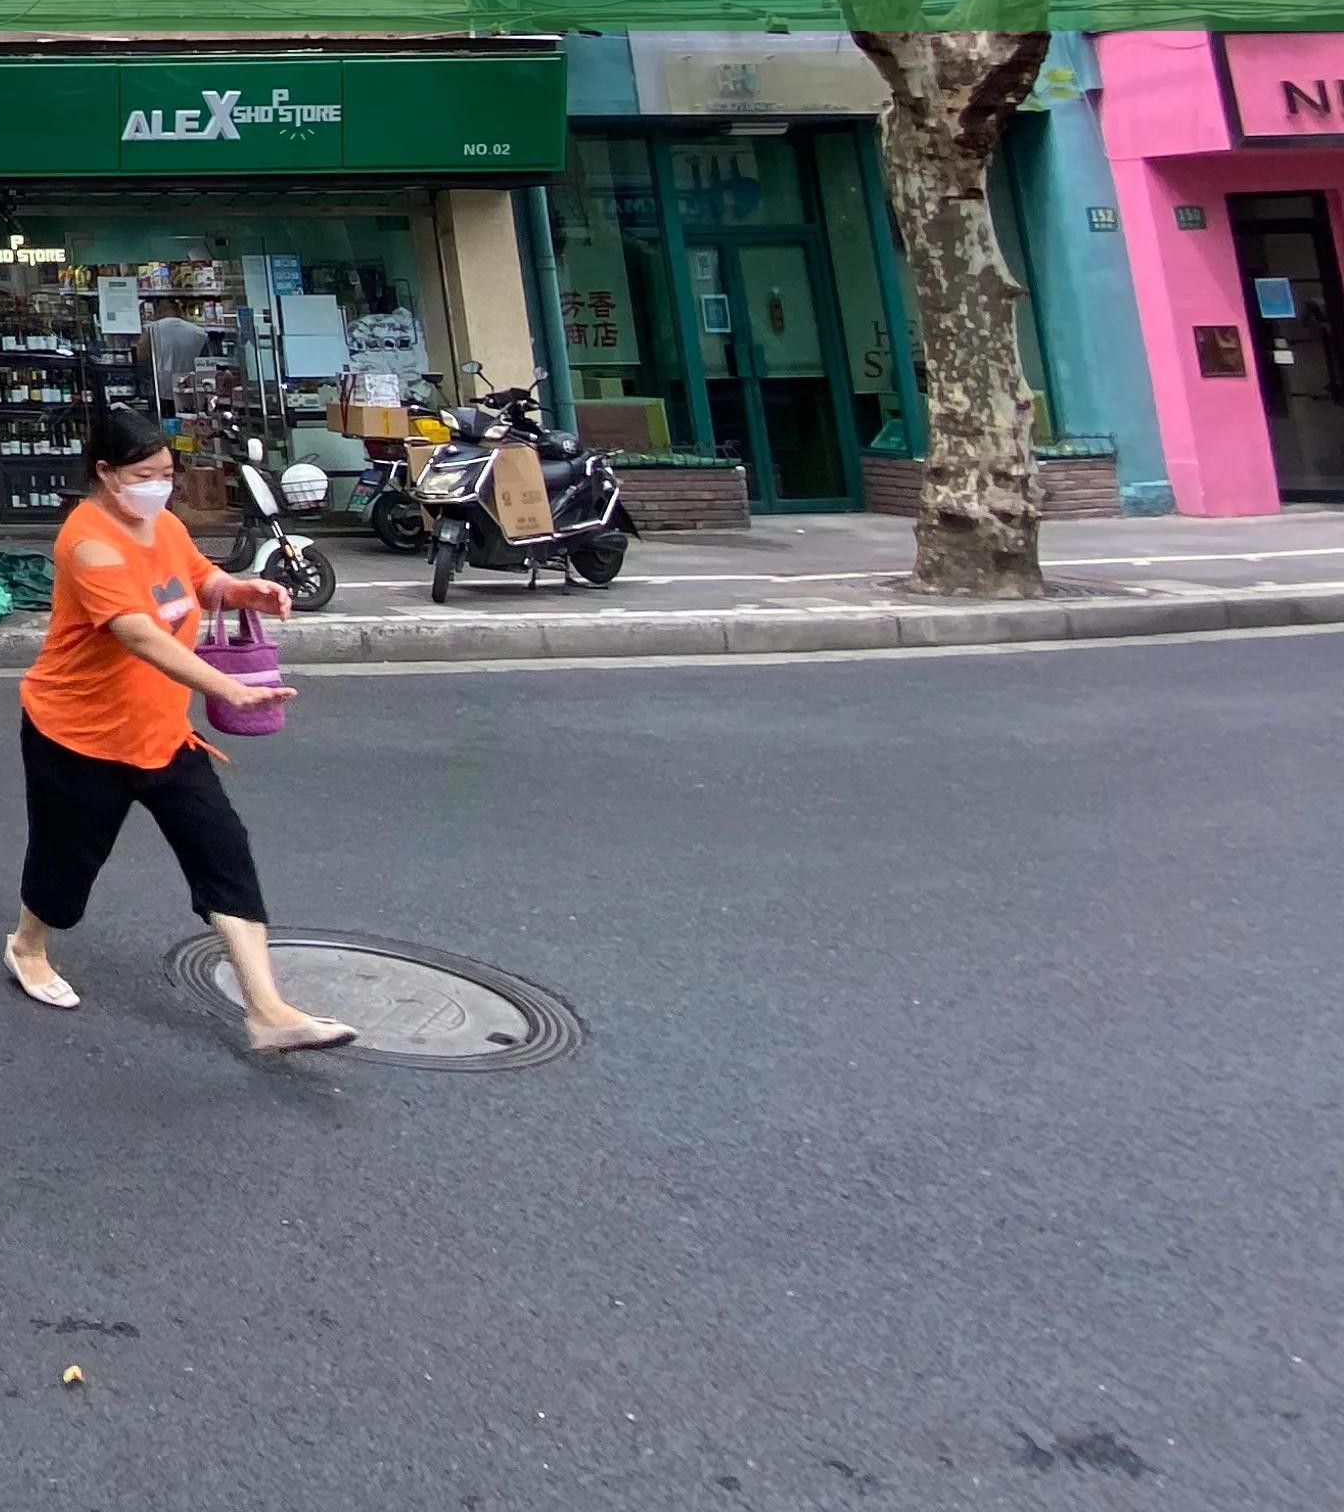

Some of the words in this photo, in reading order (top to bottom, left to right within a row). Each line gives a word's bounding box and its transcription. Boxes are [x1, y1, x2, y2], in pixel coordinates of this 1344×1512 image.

[121, 90, 242, 141] ALEX
[463, 143, 511, 157] NO.02
[564, 322, 618, 348] 商店
